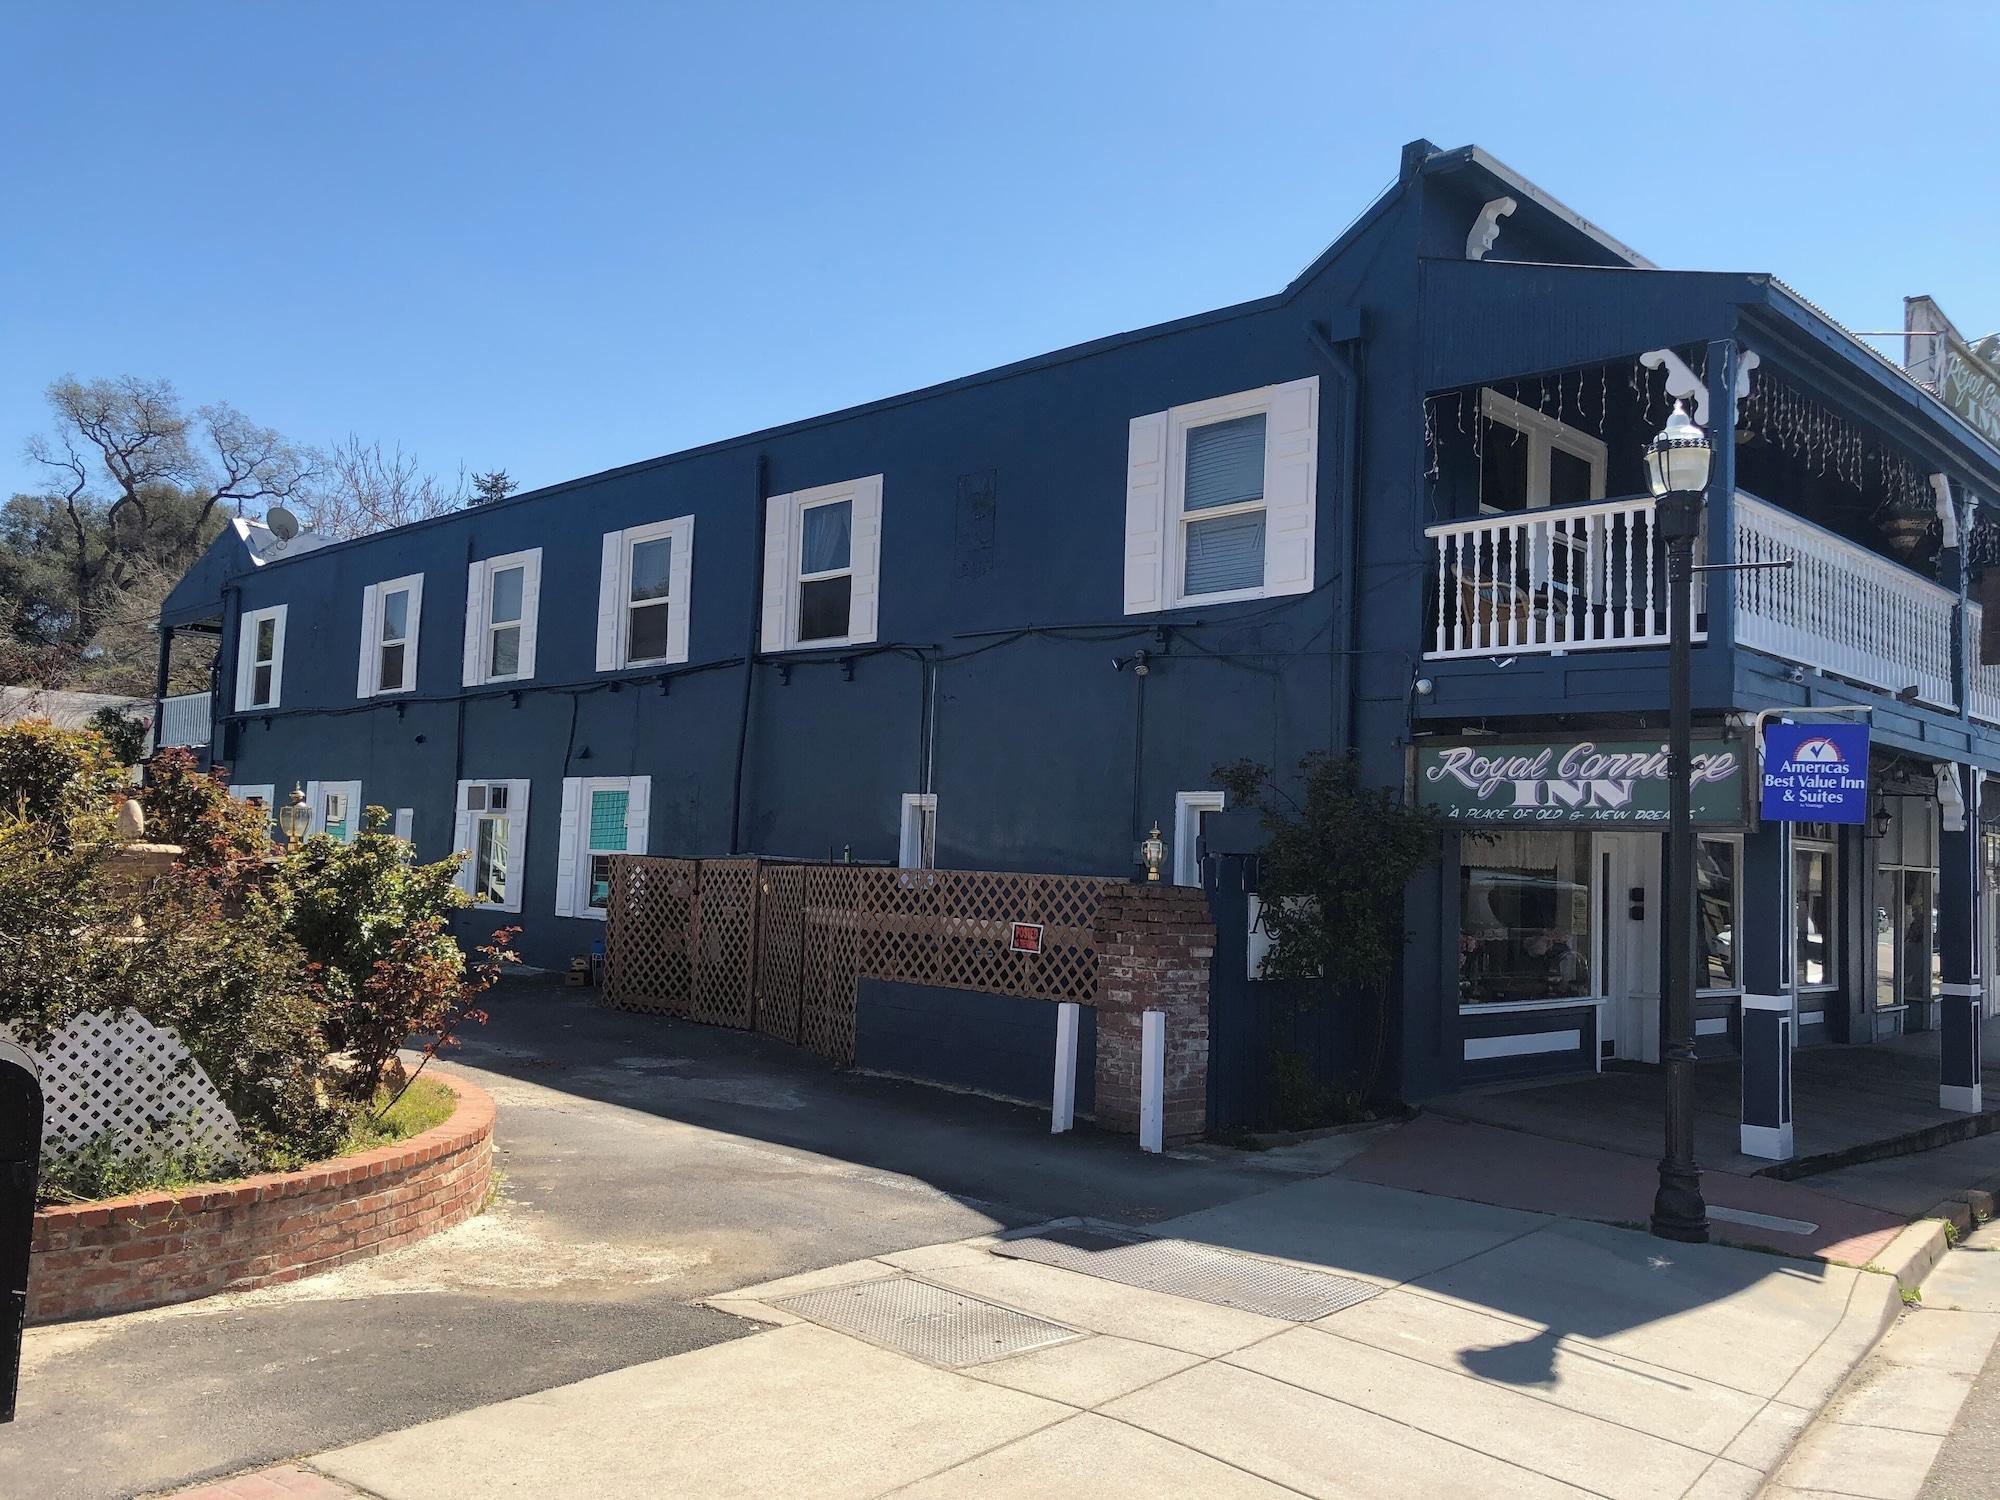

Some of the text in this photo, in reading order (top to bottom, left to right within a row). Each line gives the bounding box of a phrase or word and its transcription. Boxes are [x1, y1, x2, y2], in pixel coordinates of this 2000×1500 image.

[1426, 742, 1740, 800] Royal Carrige
[1780, 760, 1850, 774] Americas
[1764, 774, 1866, 790] Best Value Inn
[1510, 778, 1636, 808] INN
[1782, 789, 1844, 804] & Suites
[1465, 808, 1509, 820] PLACE
[1512, 808, 1534, 820] OF
[1535, 808, 1564, 820] OLD
[1568, 809, 1585, 821] &
[1590, 809, 1632, 821] NEW
